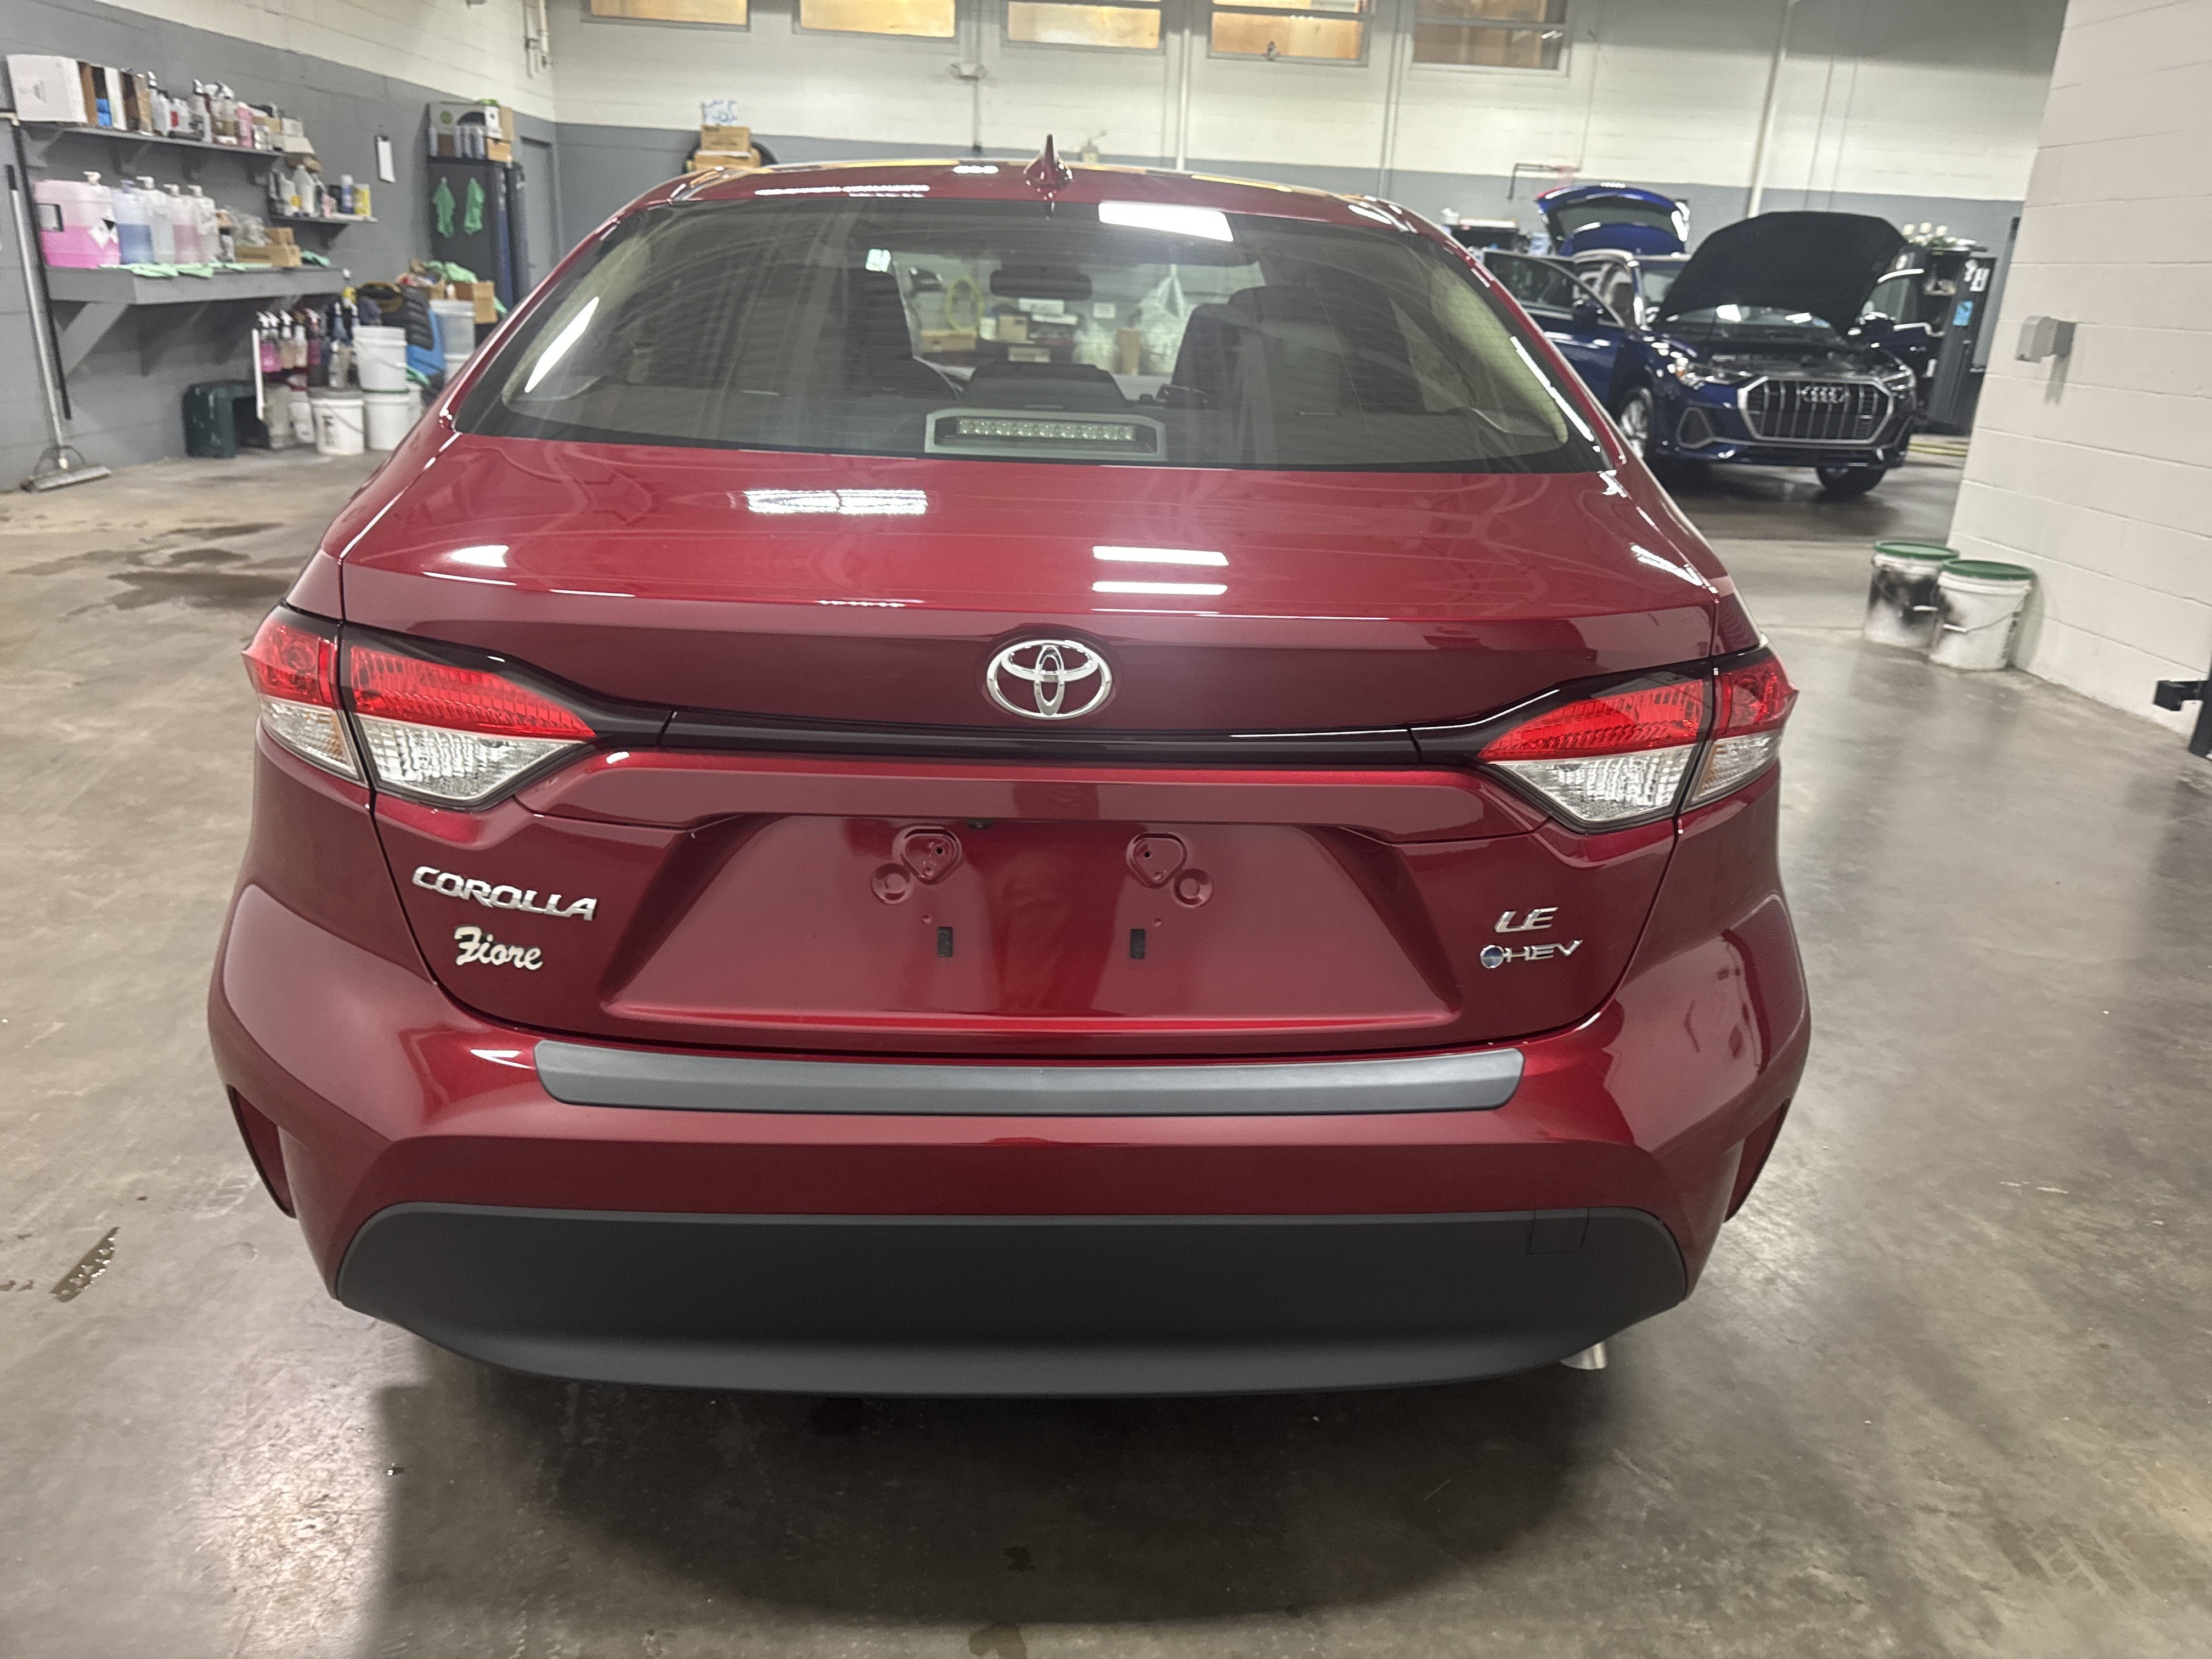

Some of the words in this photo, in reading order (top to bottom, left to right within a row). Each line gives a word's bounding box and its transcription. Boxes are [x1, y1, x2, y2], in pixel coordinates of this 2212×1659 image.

[412, 866, 598, 921] COROLLA
[1494, 907, 1559, 933] LE
[454, 925, 543, 970] Fiore
[1504, 939, 1583, 963] HEV
